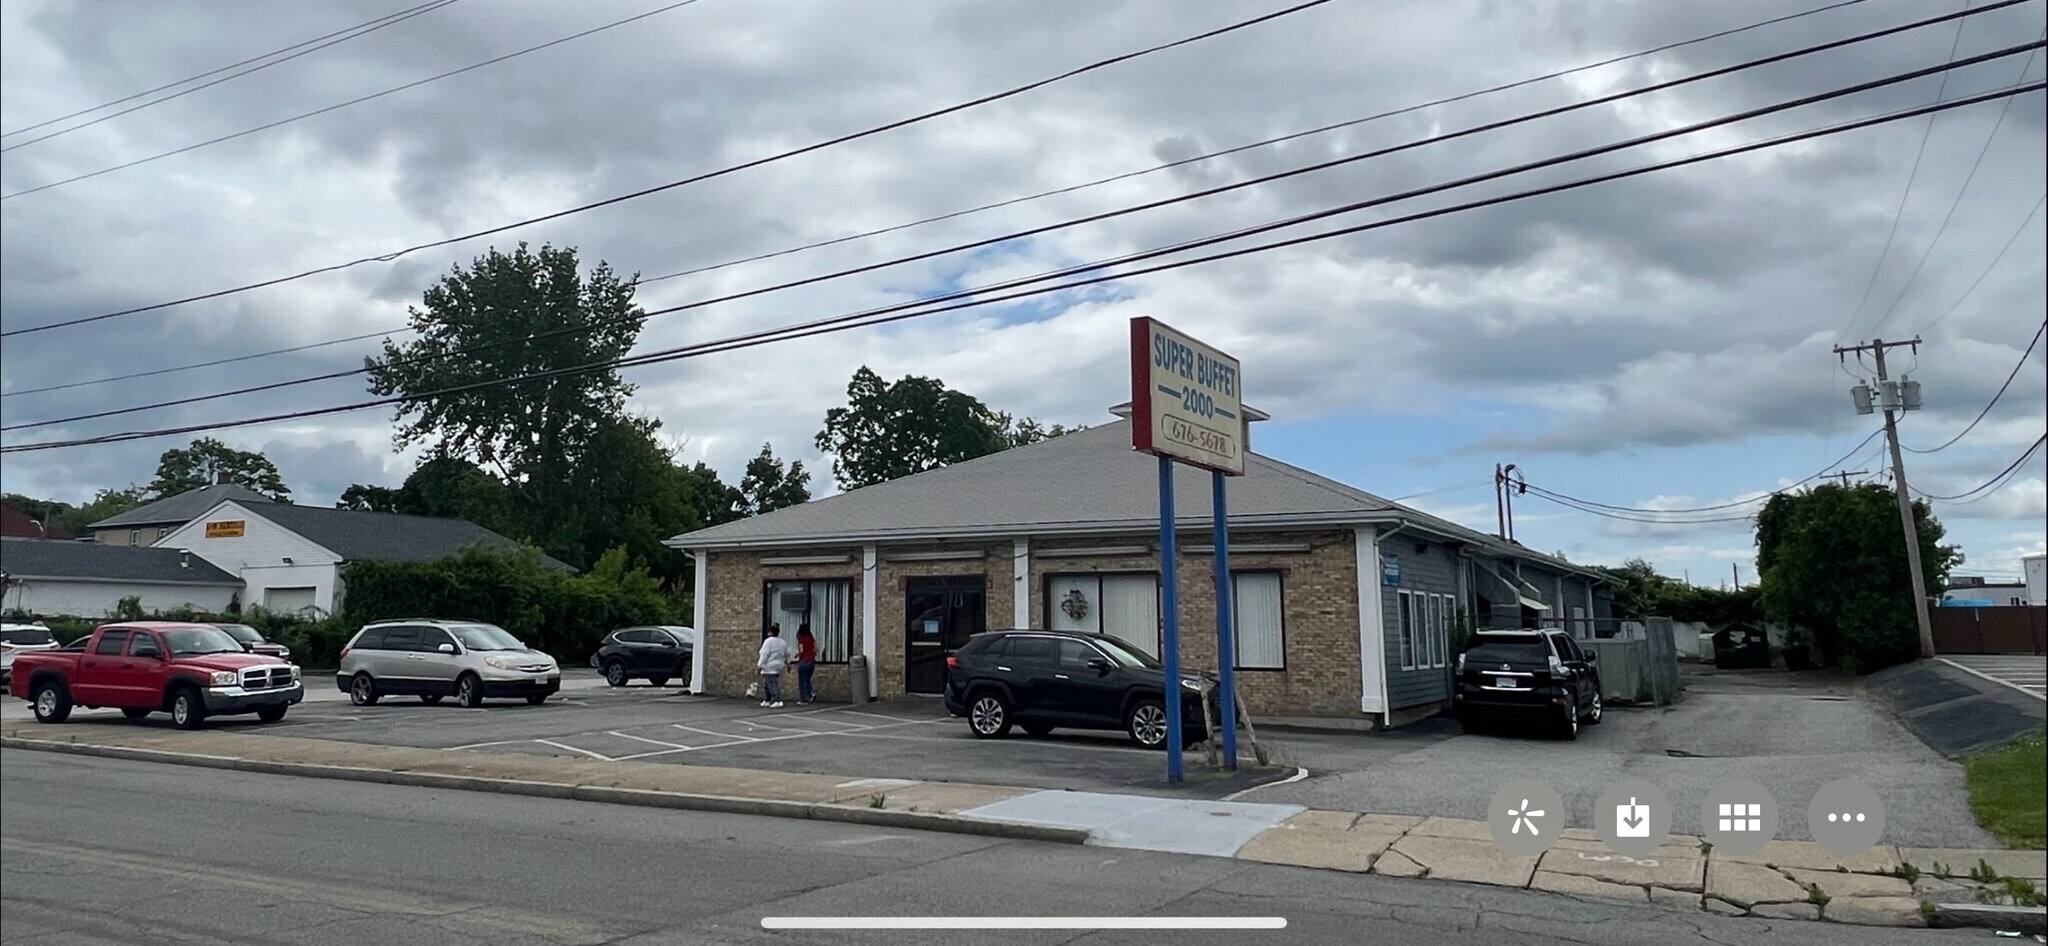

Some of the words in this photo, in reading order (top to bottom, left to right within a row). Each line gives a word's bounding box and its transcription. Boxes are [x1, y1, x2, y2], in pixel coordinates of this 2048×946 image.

[1154, 332, 1194, 381] SUPER
[1197, 352, 1236, 398] BUFFET
[1182, 386, 1214, 419] 2000
[1172, 421, 1227, 453] 676-5678
